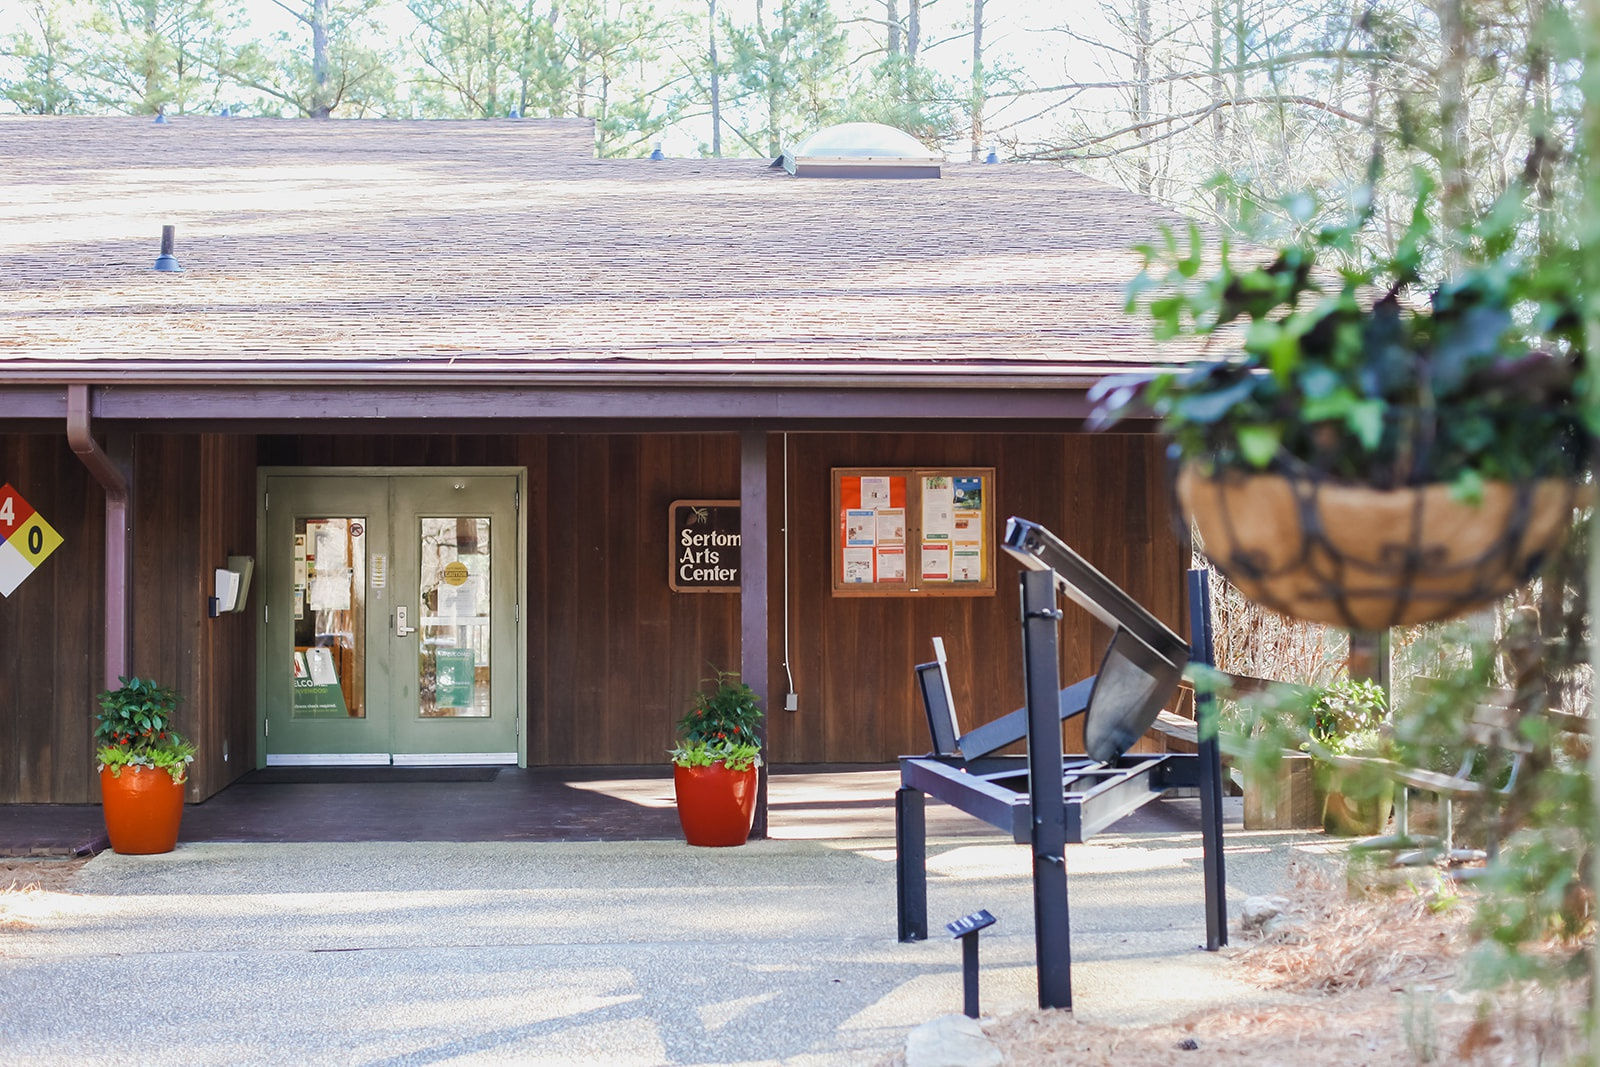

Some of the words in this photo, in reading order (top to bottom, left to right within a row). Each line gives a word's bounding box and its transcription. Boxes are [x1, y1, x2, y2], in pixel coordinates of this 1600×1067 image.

[0, 497, 15, 526] 4
[28, 525, 43, 555] 0
[680, 547, 720, 564] Arts
[680, 564, 737, 581] Center
